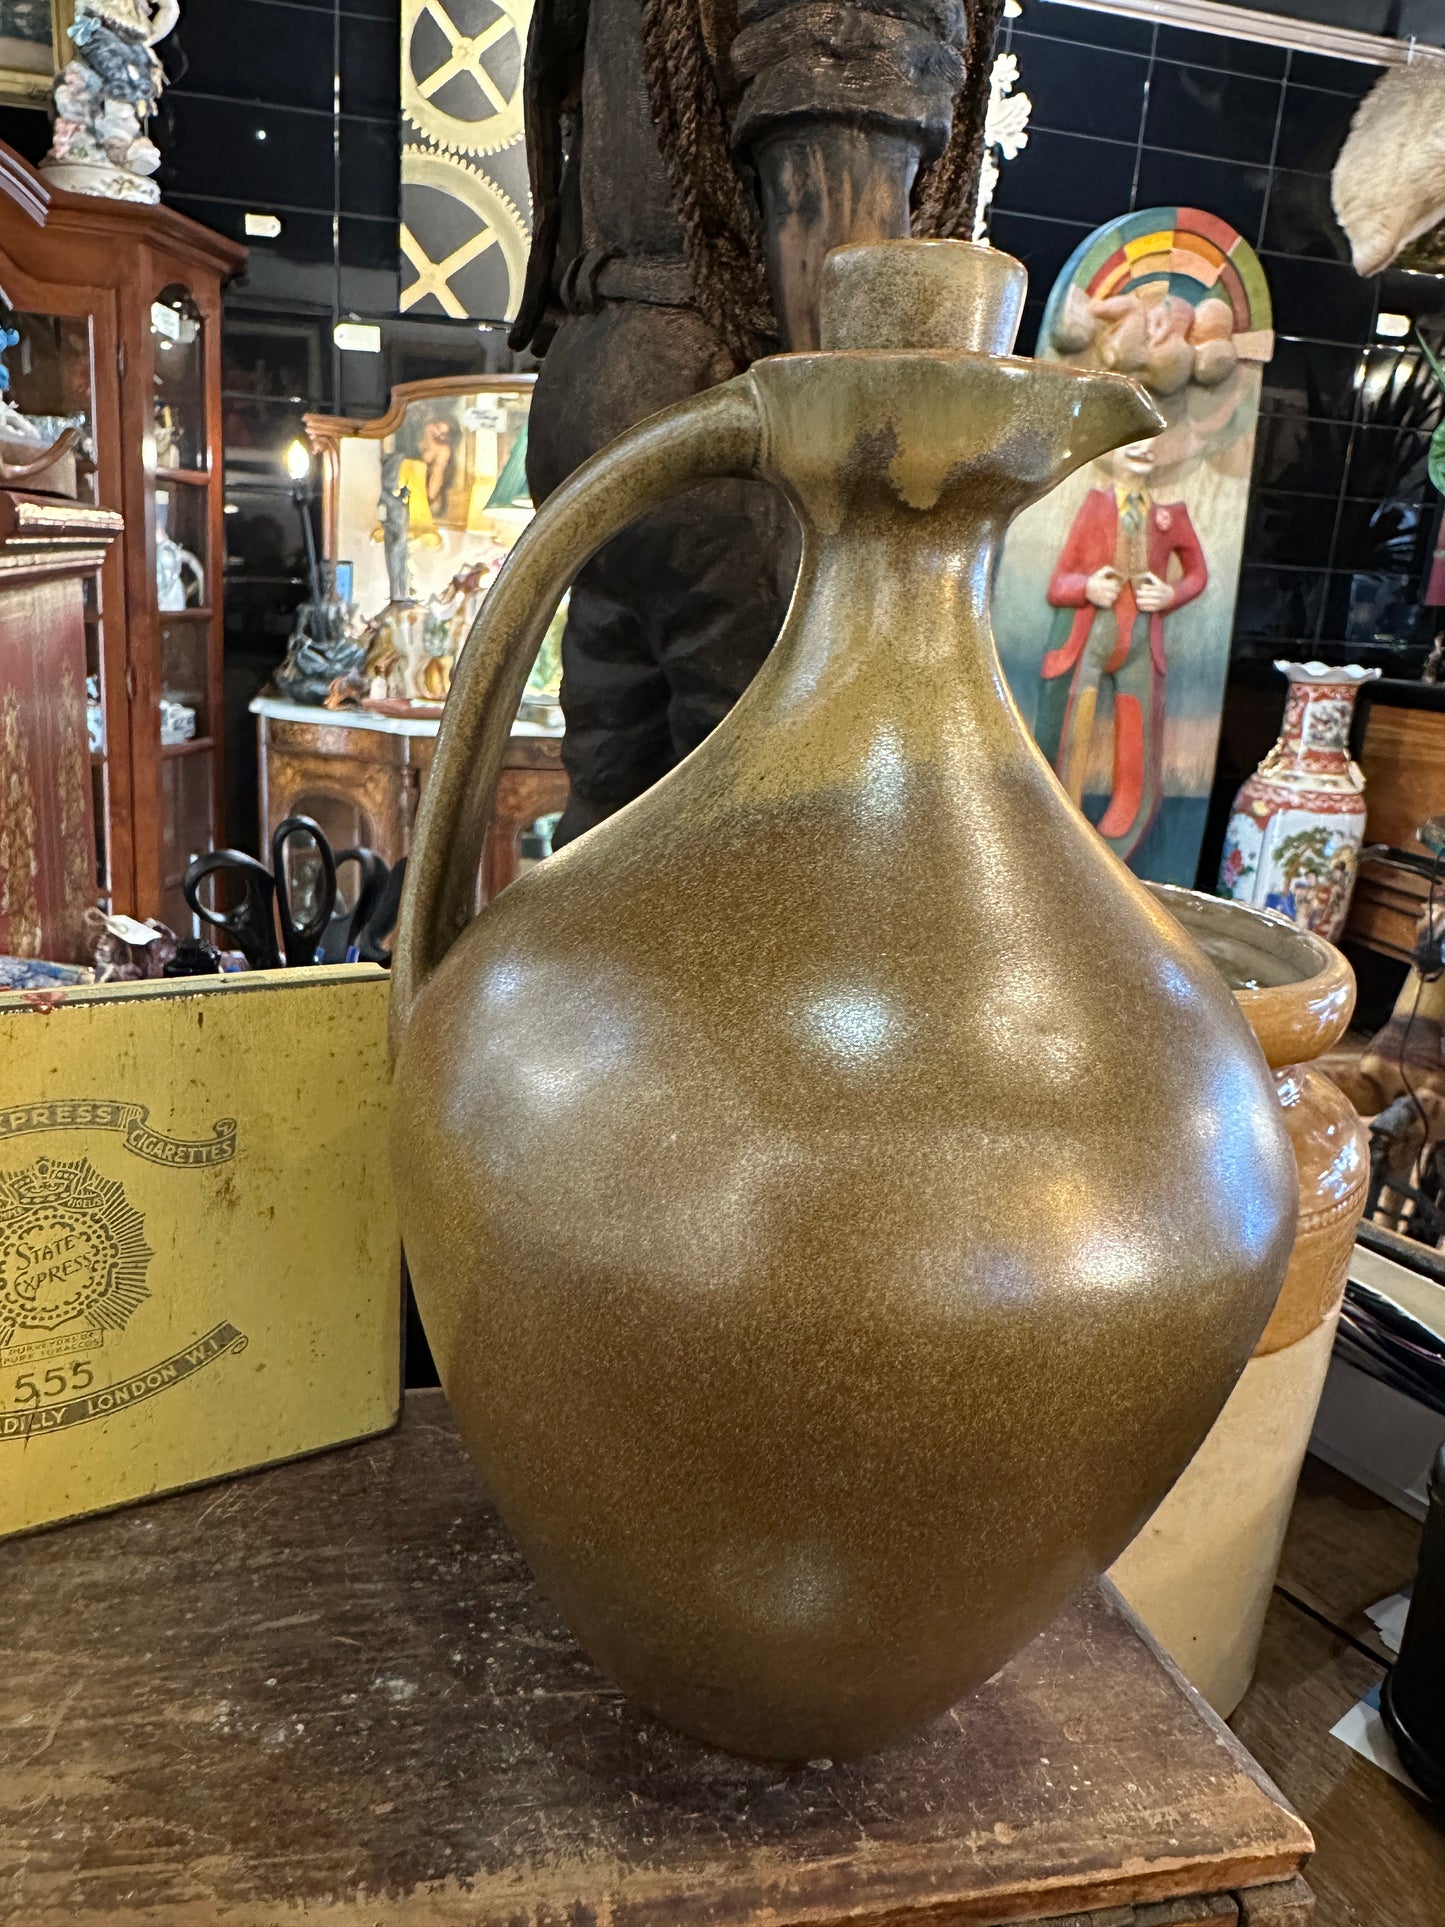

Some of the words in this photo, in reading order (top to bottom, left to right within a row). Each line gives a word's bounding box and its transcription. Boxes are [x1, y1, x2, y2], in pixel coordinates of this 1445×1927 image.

[129, 1129, 232, 1163] CIGARETTES
[16, 1235, 80, 1271] STATE
[14, 1252, 92, 1301] EXPRESS
[0, 1407, 67, 1433] DILLY
[88, 1364, 177, 1414] LONDON
[14, 1361, 94, 1403] 555
